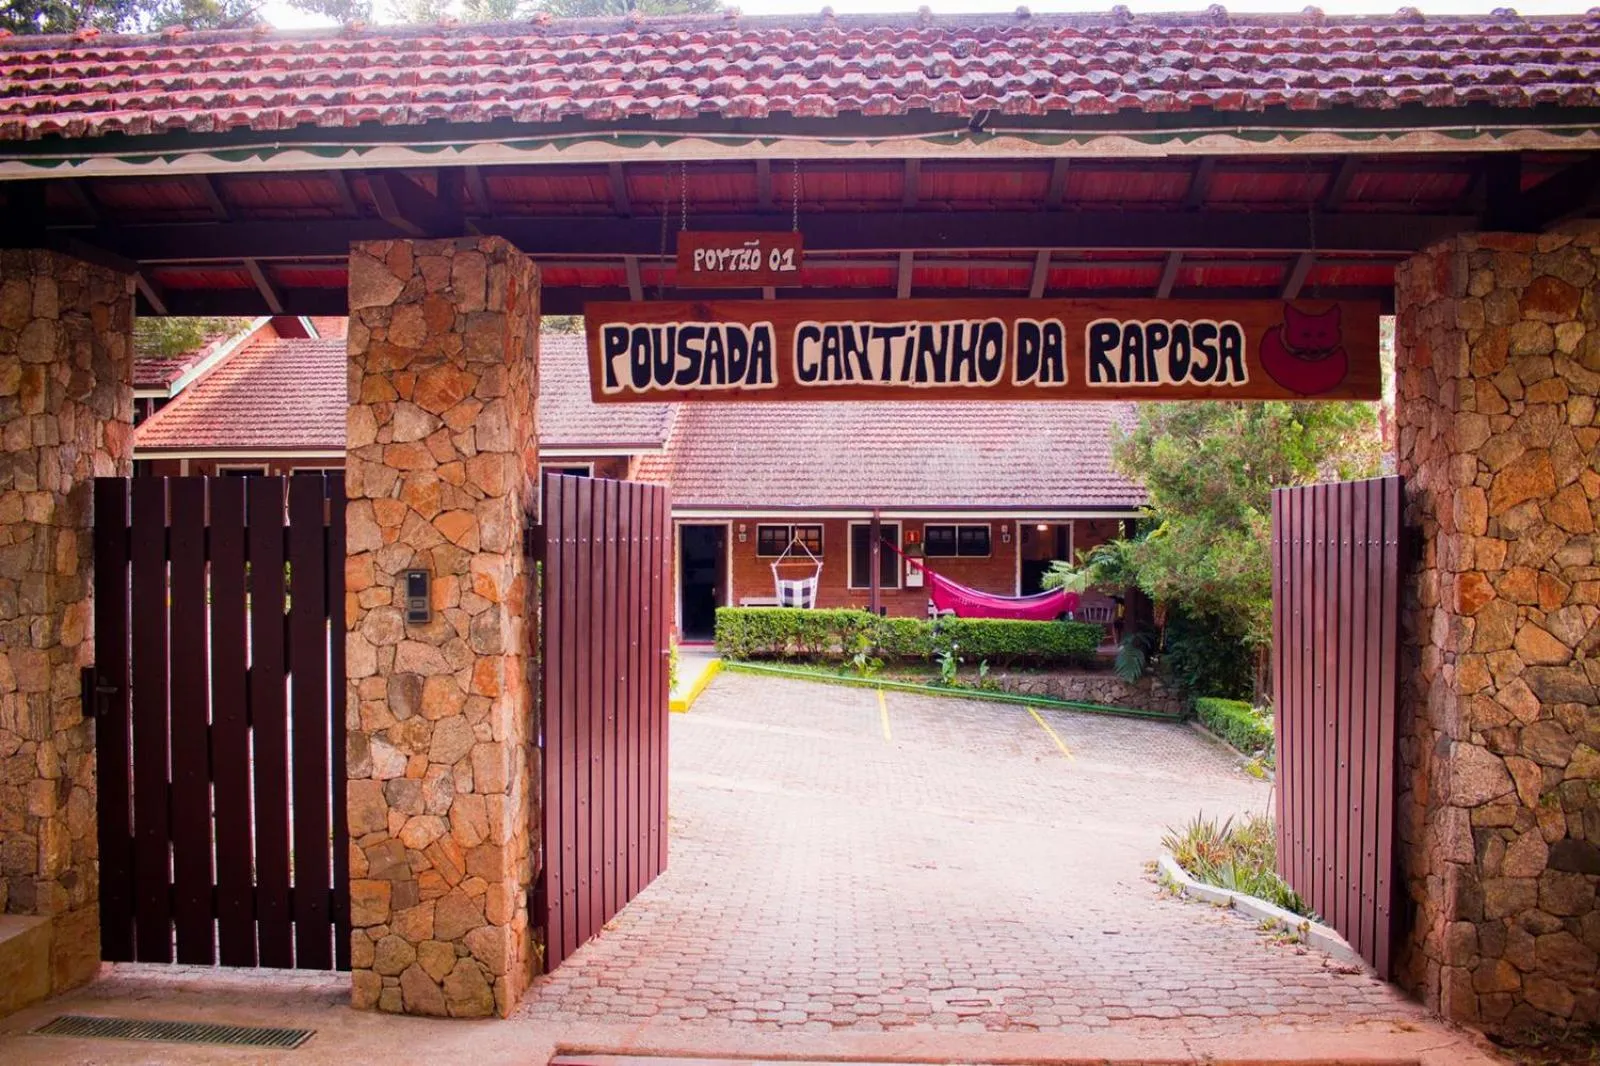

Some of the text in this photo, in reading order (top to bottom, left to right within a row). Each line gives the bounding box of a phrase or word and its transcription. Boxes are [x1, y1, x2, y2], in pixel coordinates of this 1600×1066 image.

[768, 247, 797, 272] 01
[603, 325, 774, 390] POUSADA
[1016, 322, 1065, 384] DA
[1088, 322, 1247, 384] RAPOSA
